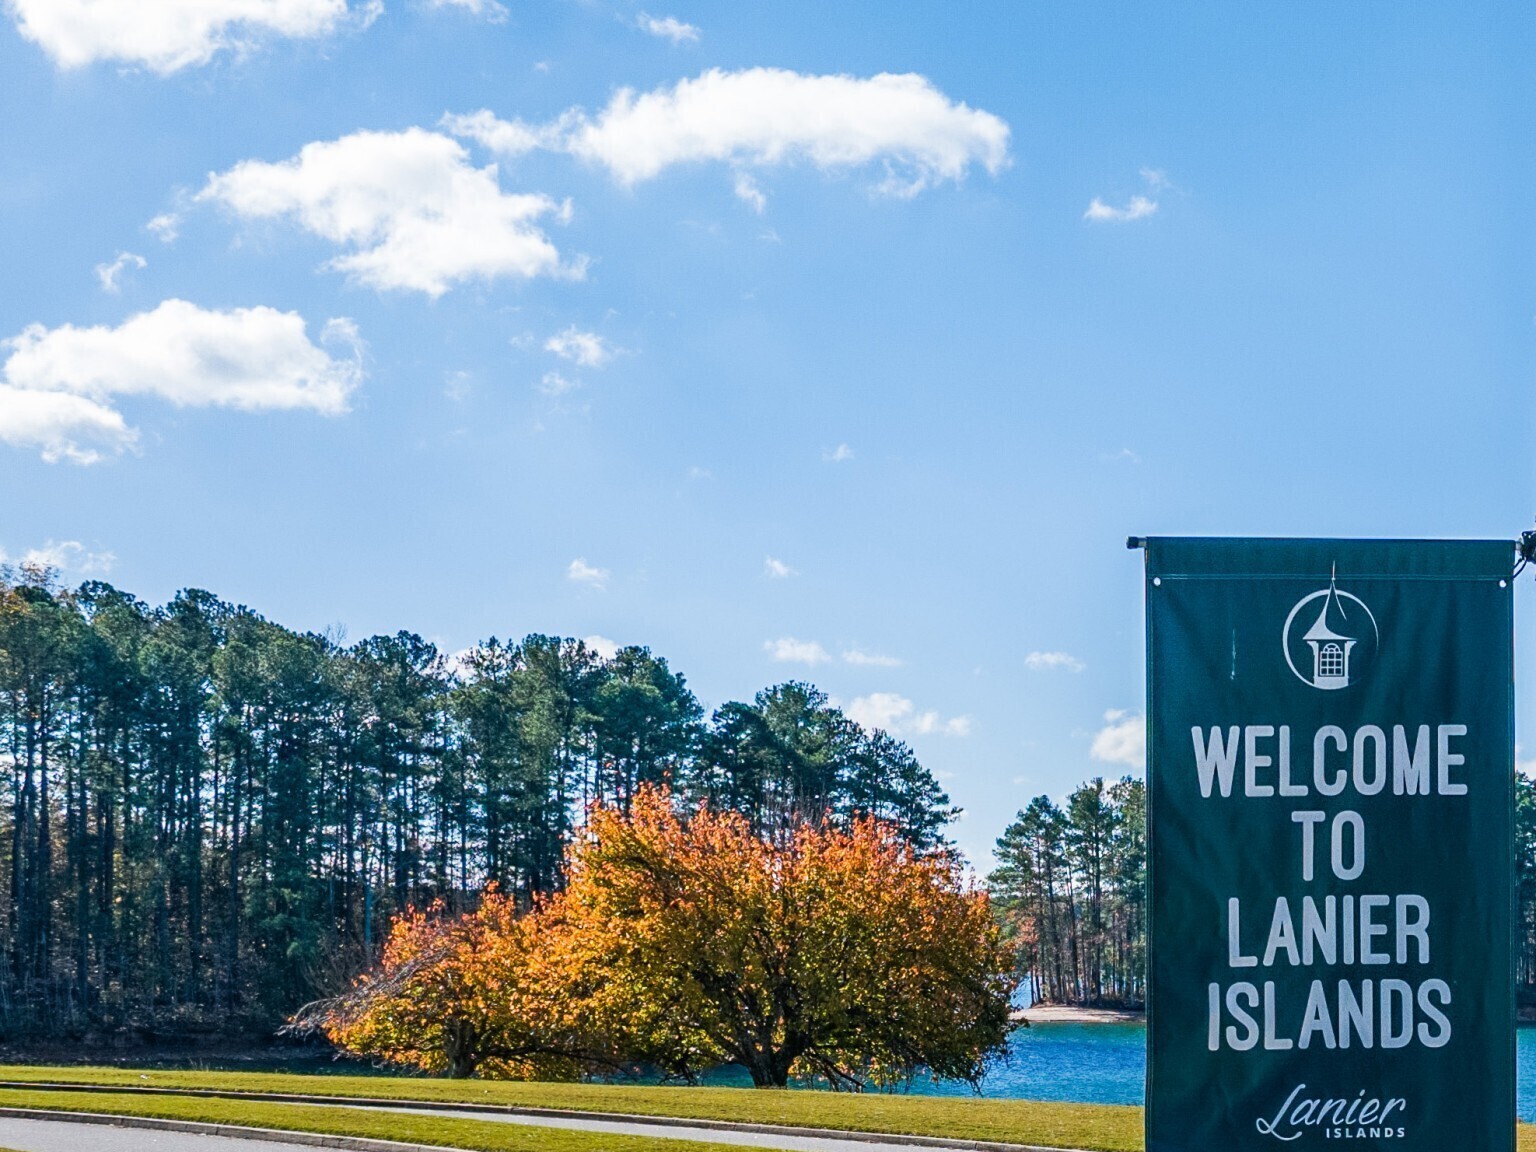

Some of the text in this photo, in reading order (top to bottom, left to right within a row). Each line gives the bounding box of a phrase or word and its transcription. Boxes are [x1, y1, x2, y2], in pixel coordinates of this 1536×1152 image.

[1191, 723, 1469, 799] WELCOME
[1291, 809, 1366, 882] TO
[1227, 894, 1431, 968] LANIER
[1206, 978, 1452, 1052] ISLANDS
[1256, 1083, 1407, 1142] Lanier
[1325, 1126, 1406, 1140] ISLANDS
